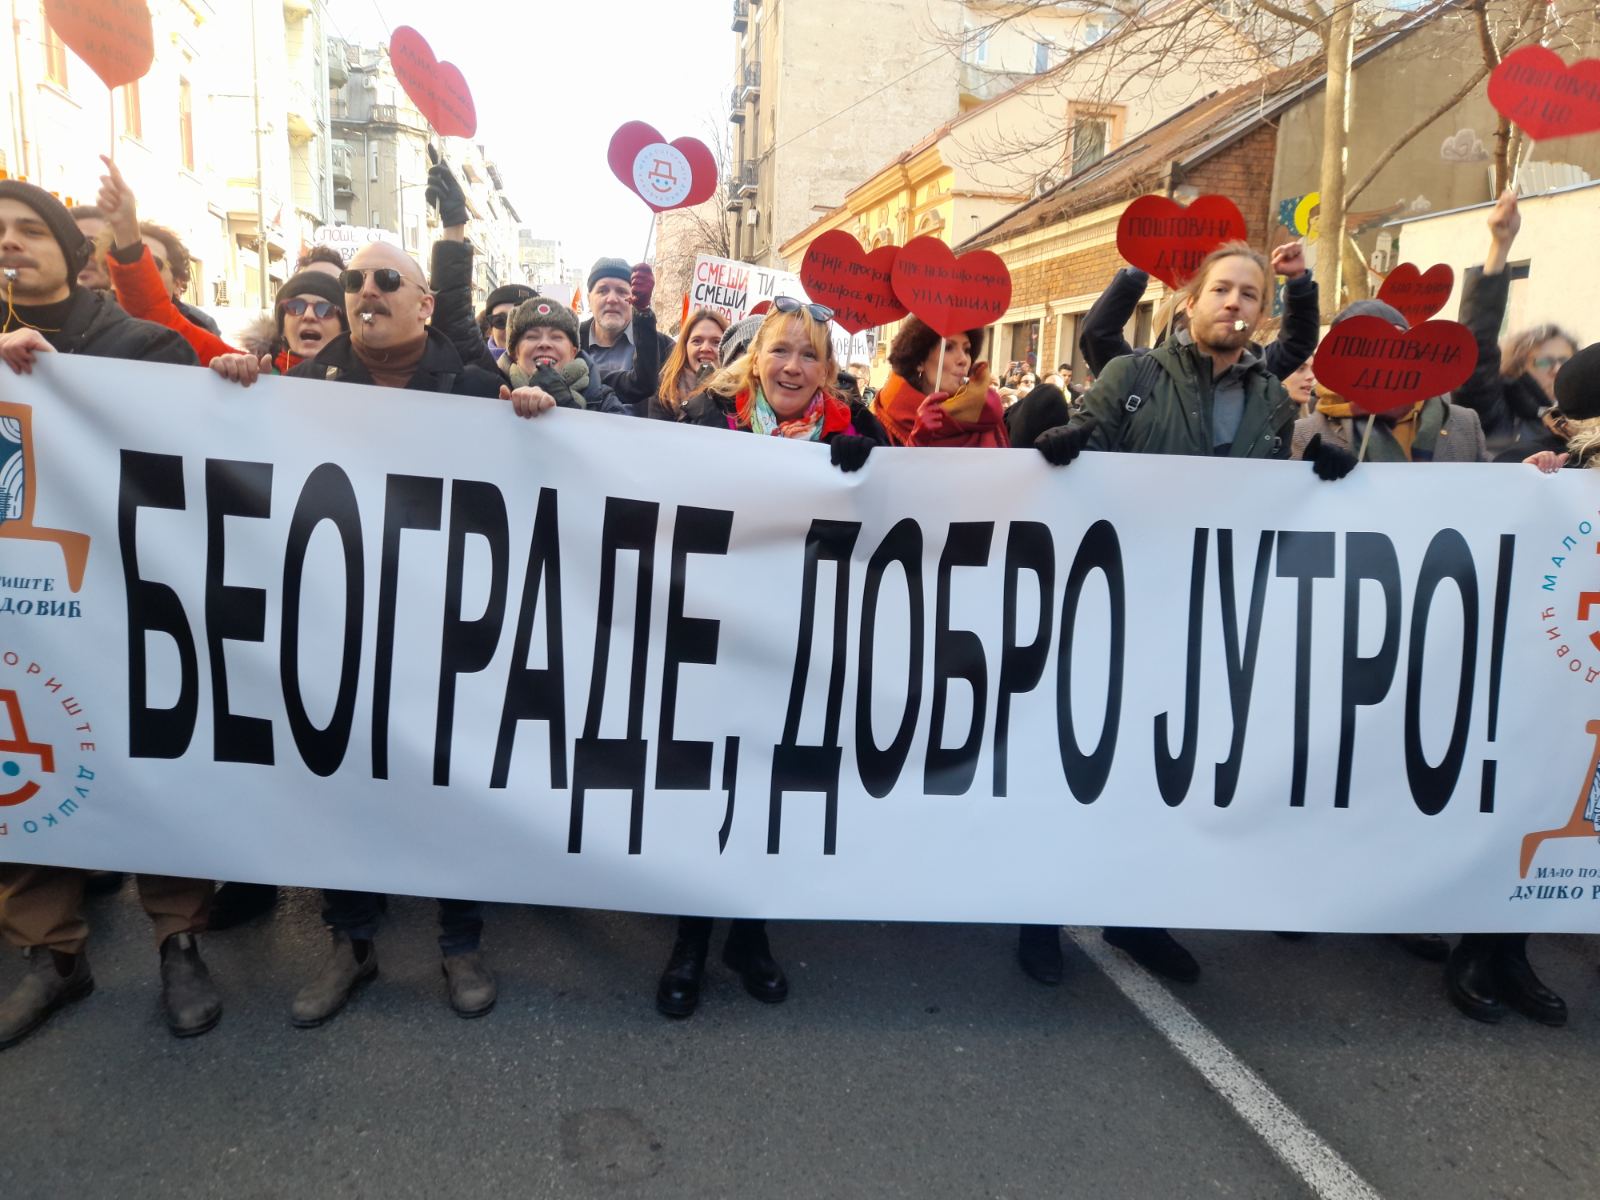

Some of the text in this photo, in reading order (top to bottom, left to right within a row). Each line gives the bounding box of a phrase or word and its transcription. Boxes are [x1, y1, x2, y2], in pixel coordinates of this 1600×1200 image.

[697, 262, 750, 293] СМЕШИ
[757, 272, 776, 297] ТИ
[695, 284, 747, 311] СМЕШИ
[1331, 336, 1462, 364] ПОШТОВАНА
[1351, 367, 1423, 391] ДЕЦО
[1542, 521, 1592, 591] МАЛО
[0, 576, 55, 592] ИШТЕ
[118, 448, 1517, 856] БЕОГРАДЕ, ДОБРО ЈУТРО!
[23, 765, 95, 834] ДУШКО
[1535, 866, 1574, 879] МАЛО
[1509, 885, 1584, 902] ДУШКО
